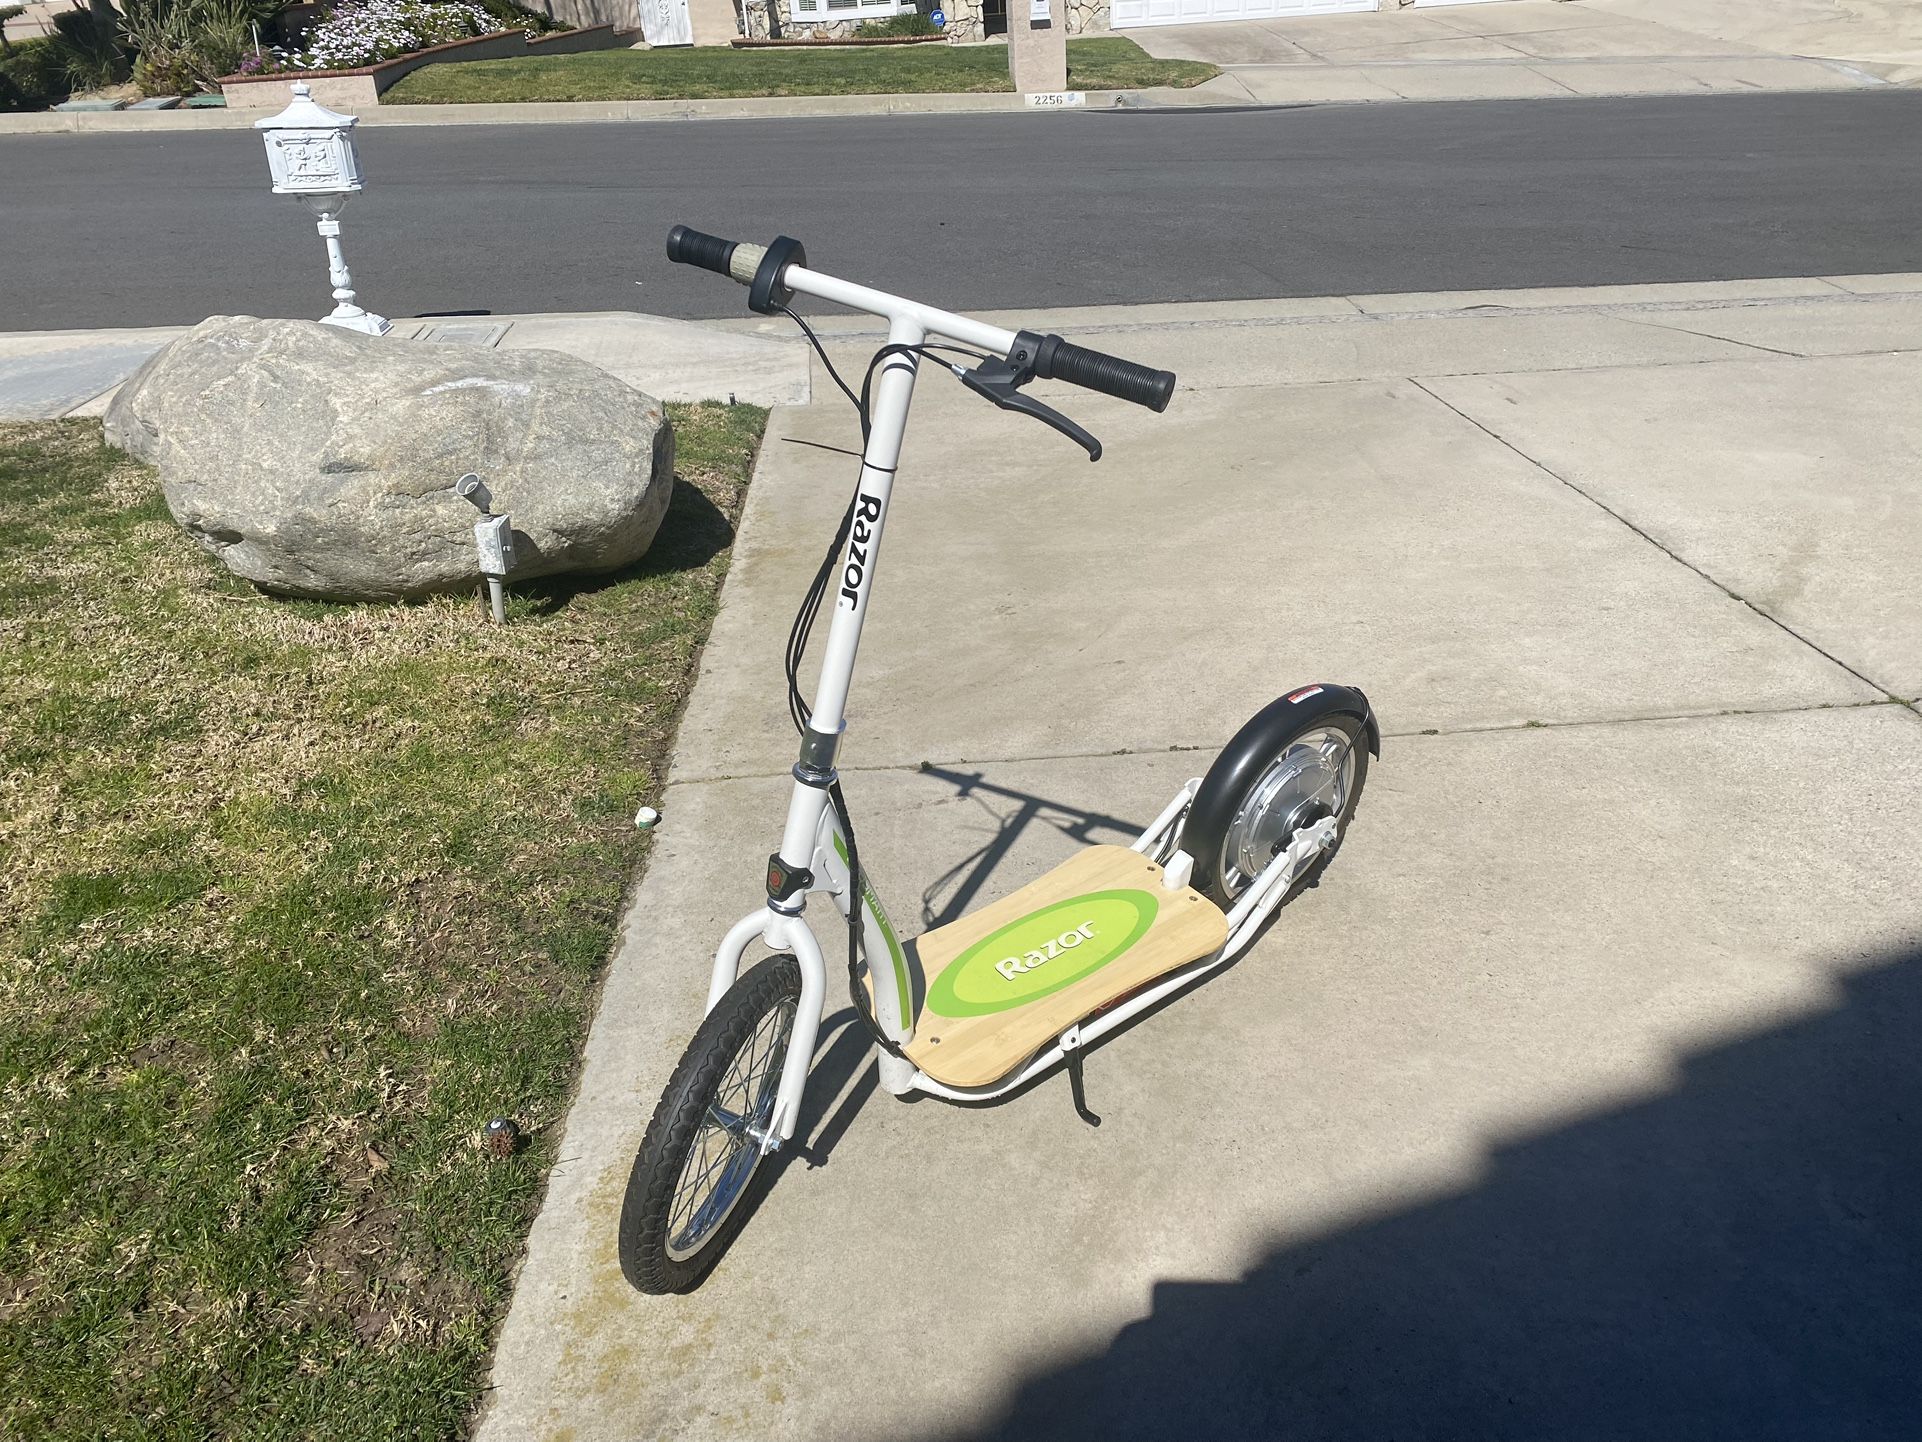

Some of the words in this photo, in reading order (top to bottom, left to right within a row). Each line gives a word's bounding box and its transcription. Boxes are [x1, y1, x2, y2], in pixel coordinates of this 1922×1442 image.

[1034, 95, 1063, 105] 2256
[841, 493, 882, 611] Razor
[995, 920, 1095, 981] Razor
